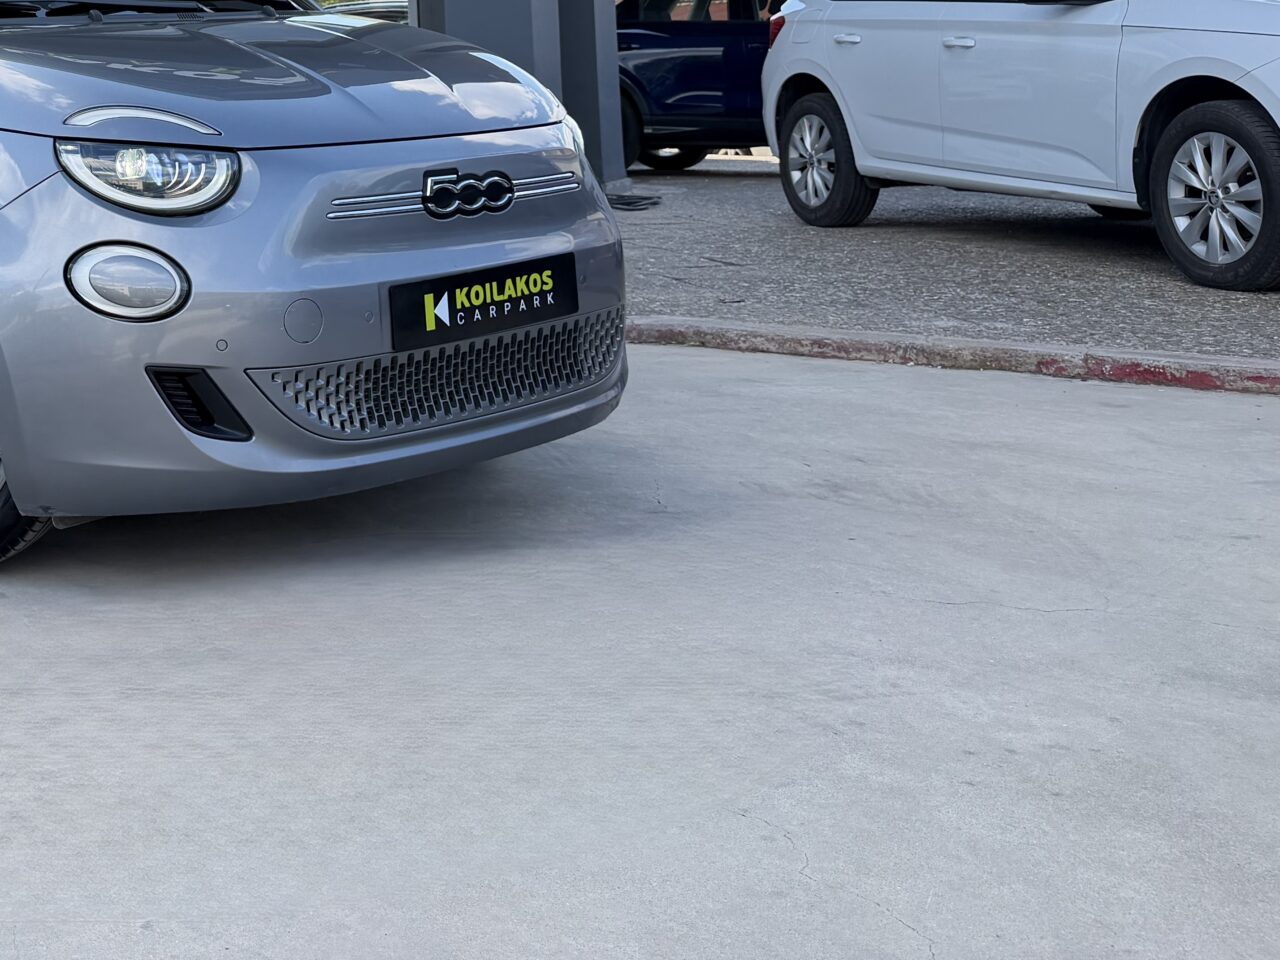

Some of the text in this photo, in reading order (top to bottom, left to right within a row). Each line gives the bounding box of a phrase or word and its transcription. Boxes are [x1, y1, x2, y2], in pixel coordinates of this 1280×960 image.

[426, 172, 514, 217] 500
[455, 270, 554, 310] KOILAKOS
[457, 292, 554, 325] CARPARK
